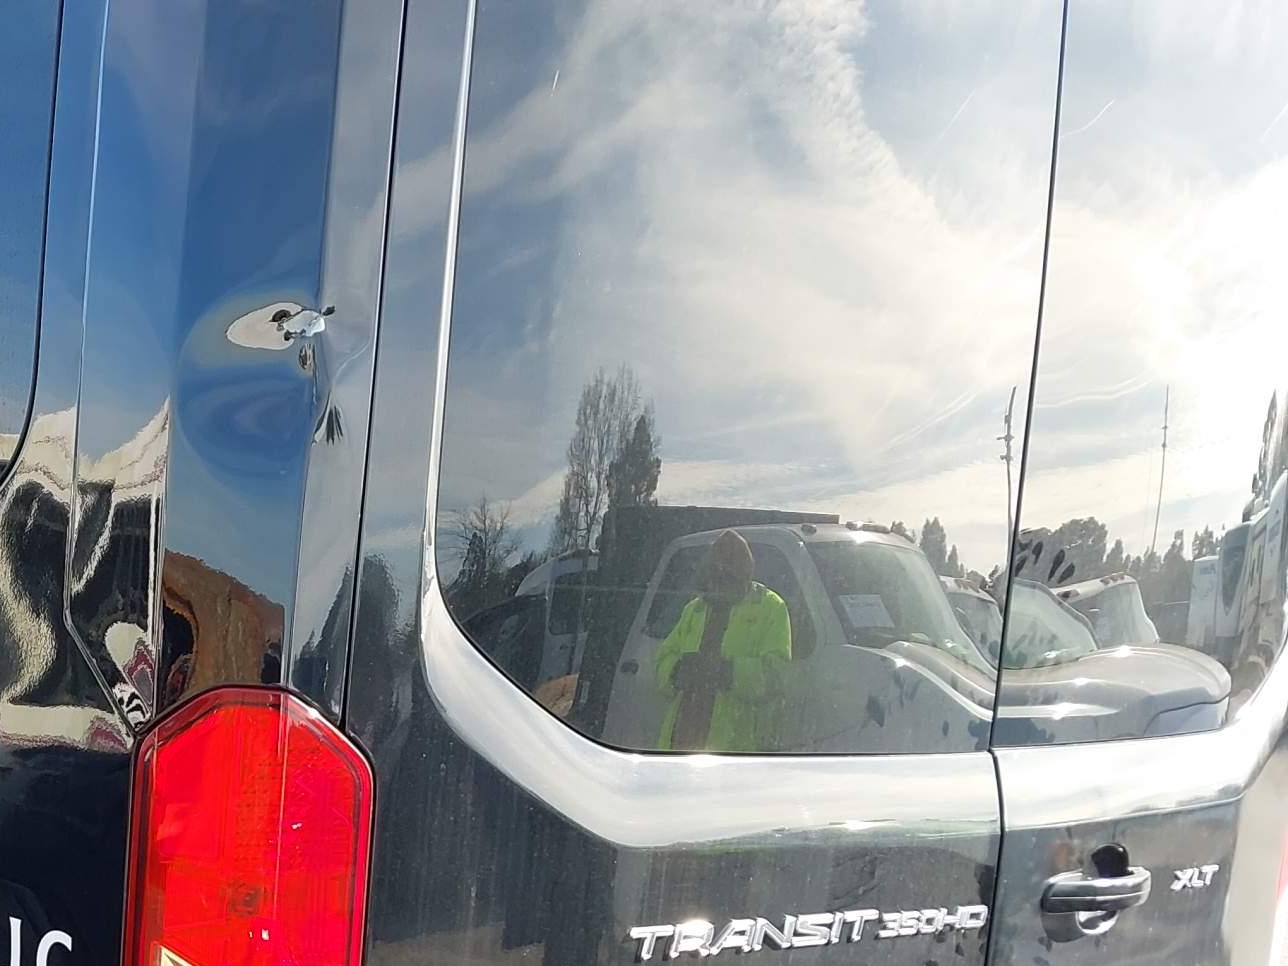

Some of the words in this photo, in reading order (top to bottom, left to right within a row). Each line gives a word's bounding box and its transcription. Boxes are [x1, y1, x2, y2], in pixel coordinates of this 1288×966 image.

[1170, 864, 1219, 891] XLT
[628, 908, 880, 961] TRANSIT
[877, 904, 989, 939] 350HD
